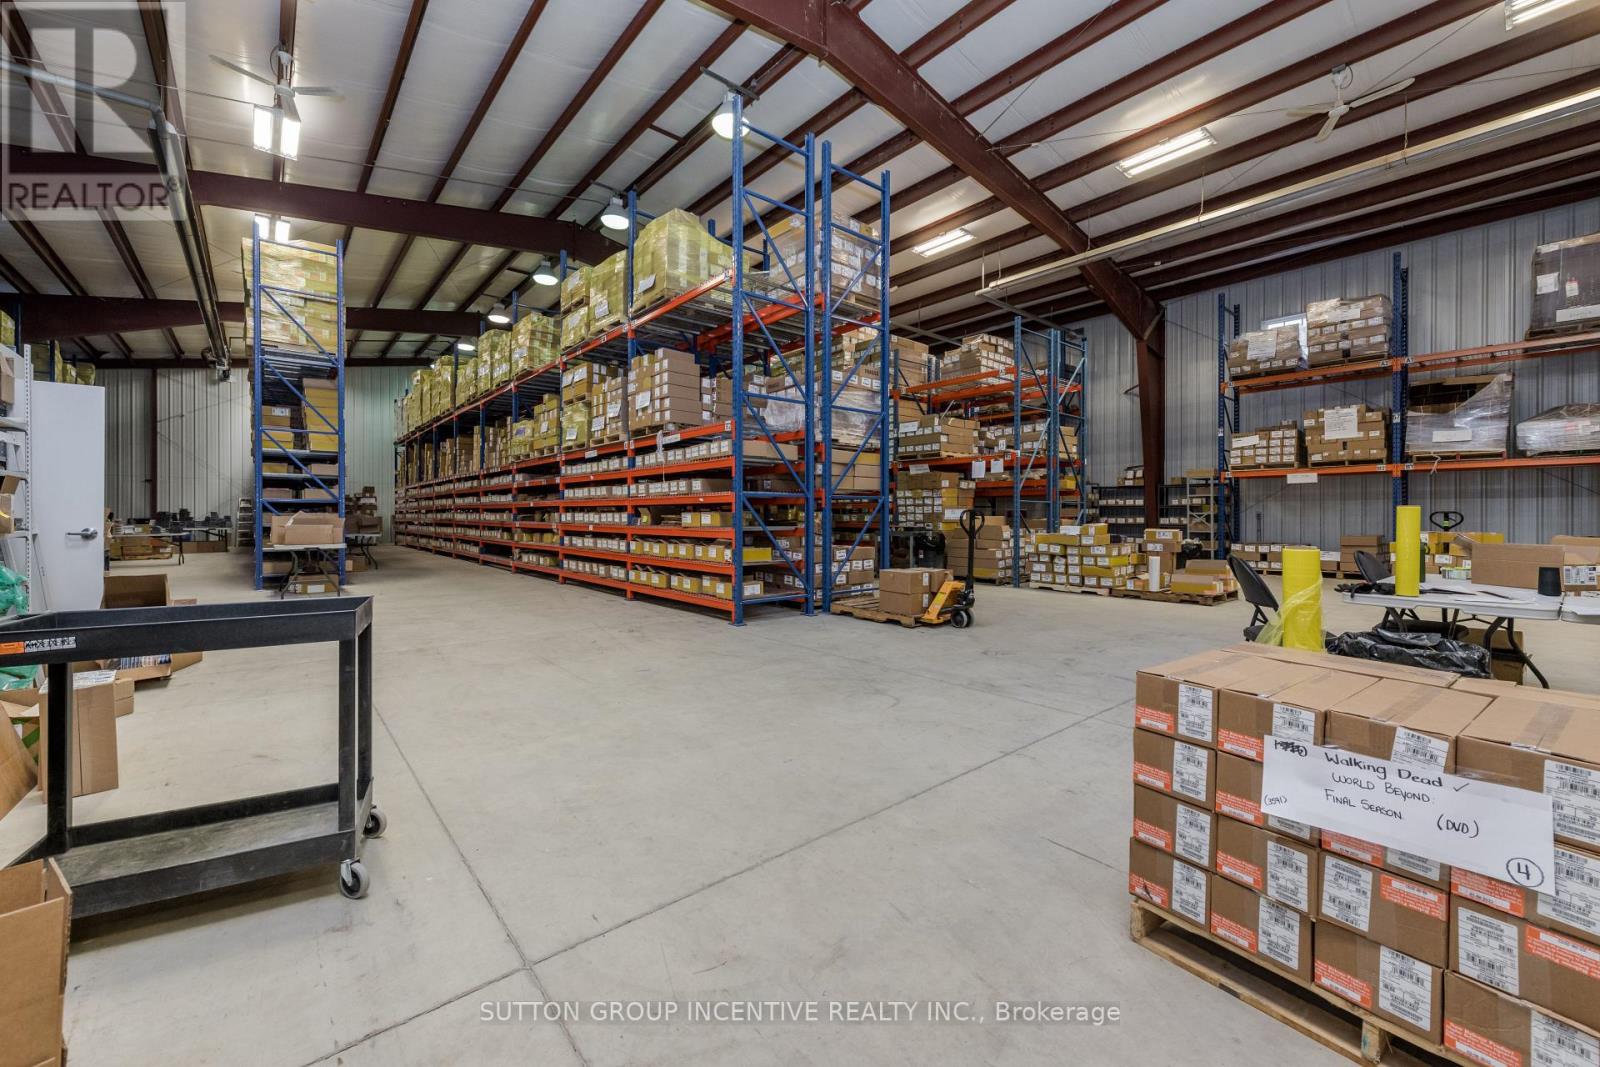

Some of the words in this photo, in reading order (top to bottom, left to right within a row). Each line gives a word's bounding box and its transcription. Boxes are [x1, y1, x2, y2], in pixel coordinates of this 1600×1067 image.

[1324, 751, 1387, 780] Walking
[1397, 768, 1444, 788] Dead
[1331, 772, 1375, 790] WORLD
[1384, 781, 1431, 803] BEYOND
[1324, 788, 1356, 807] FINAL
[1360, 799, 1402, 820] SEASON
[1436, 813, 1480, 839] (DVD)
[1516, 861, 1531, 881] 4
